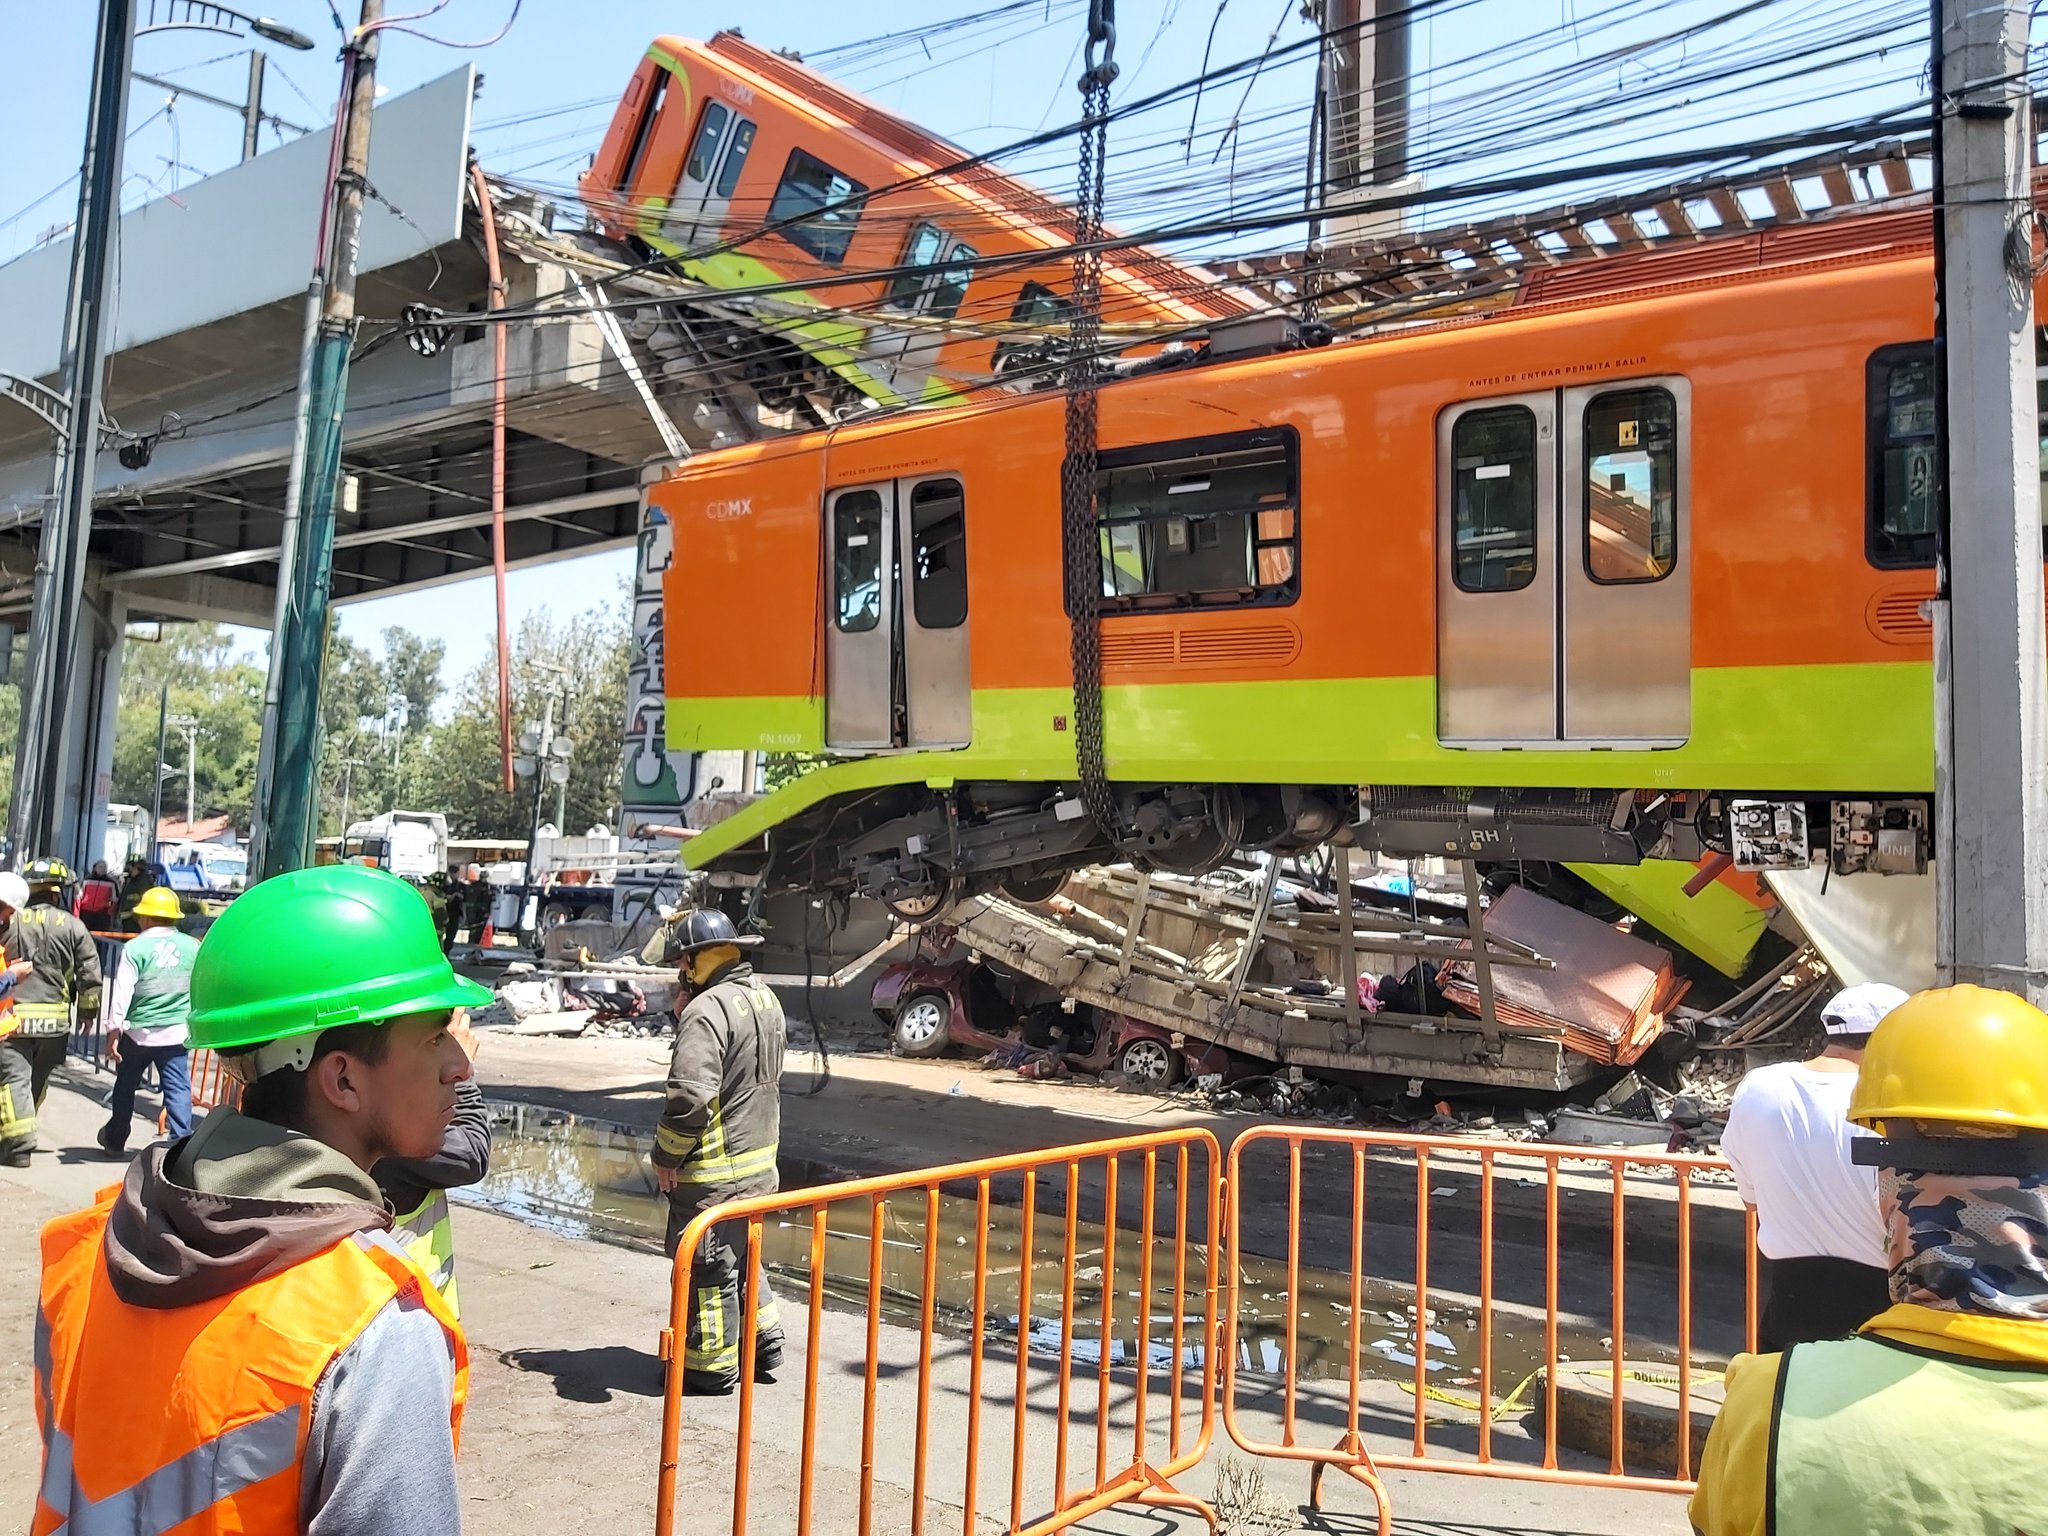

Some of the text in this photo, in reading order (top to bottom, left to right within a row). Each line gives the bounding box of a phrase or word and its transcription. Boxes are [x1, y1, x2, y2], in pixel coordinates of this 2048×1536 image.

[1469, 356, 1647, 388] ANTES DE ENTRAR PERMITA SALIR
[706, 498, 752, 519] CDMX
[1471, 829, 1500, 842] RH
[1881, 843, 1911, 857] UNF
[732, 988, 782, 1018] CDM
